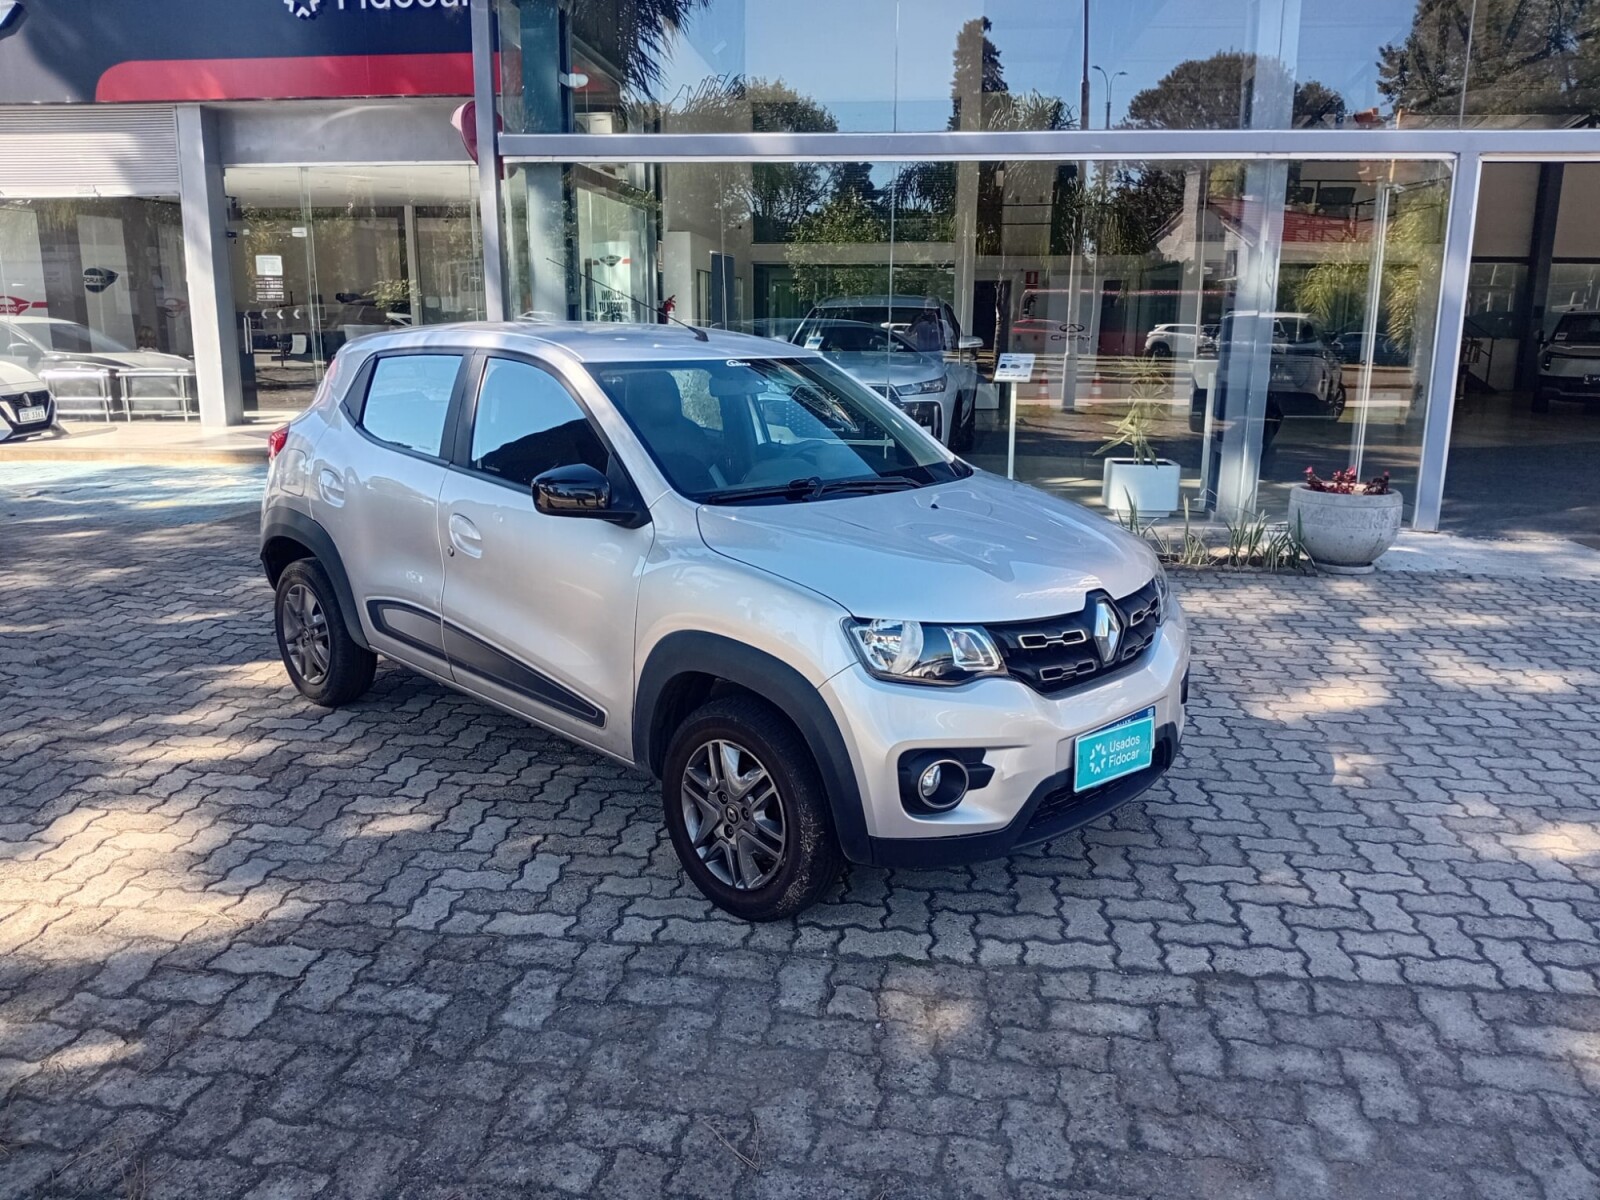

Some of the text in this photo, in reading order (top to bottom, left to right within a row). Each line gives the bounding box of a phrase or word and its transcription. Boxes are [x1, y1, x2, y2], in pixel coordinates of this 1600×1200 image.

[599, 302, 606, 313] TU
[1109, 735, 1141, 753] Usados
[1108, 749, 1140, 768] Fidocar
